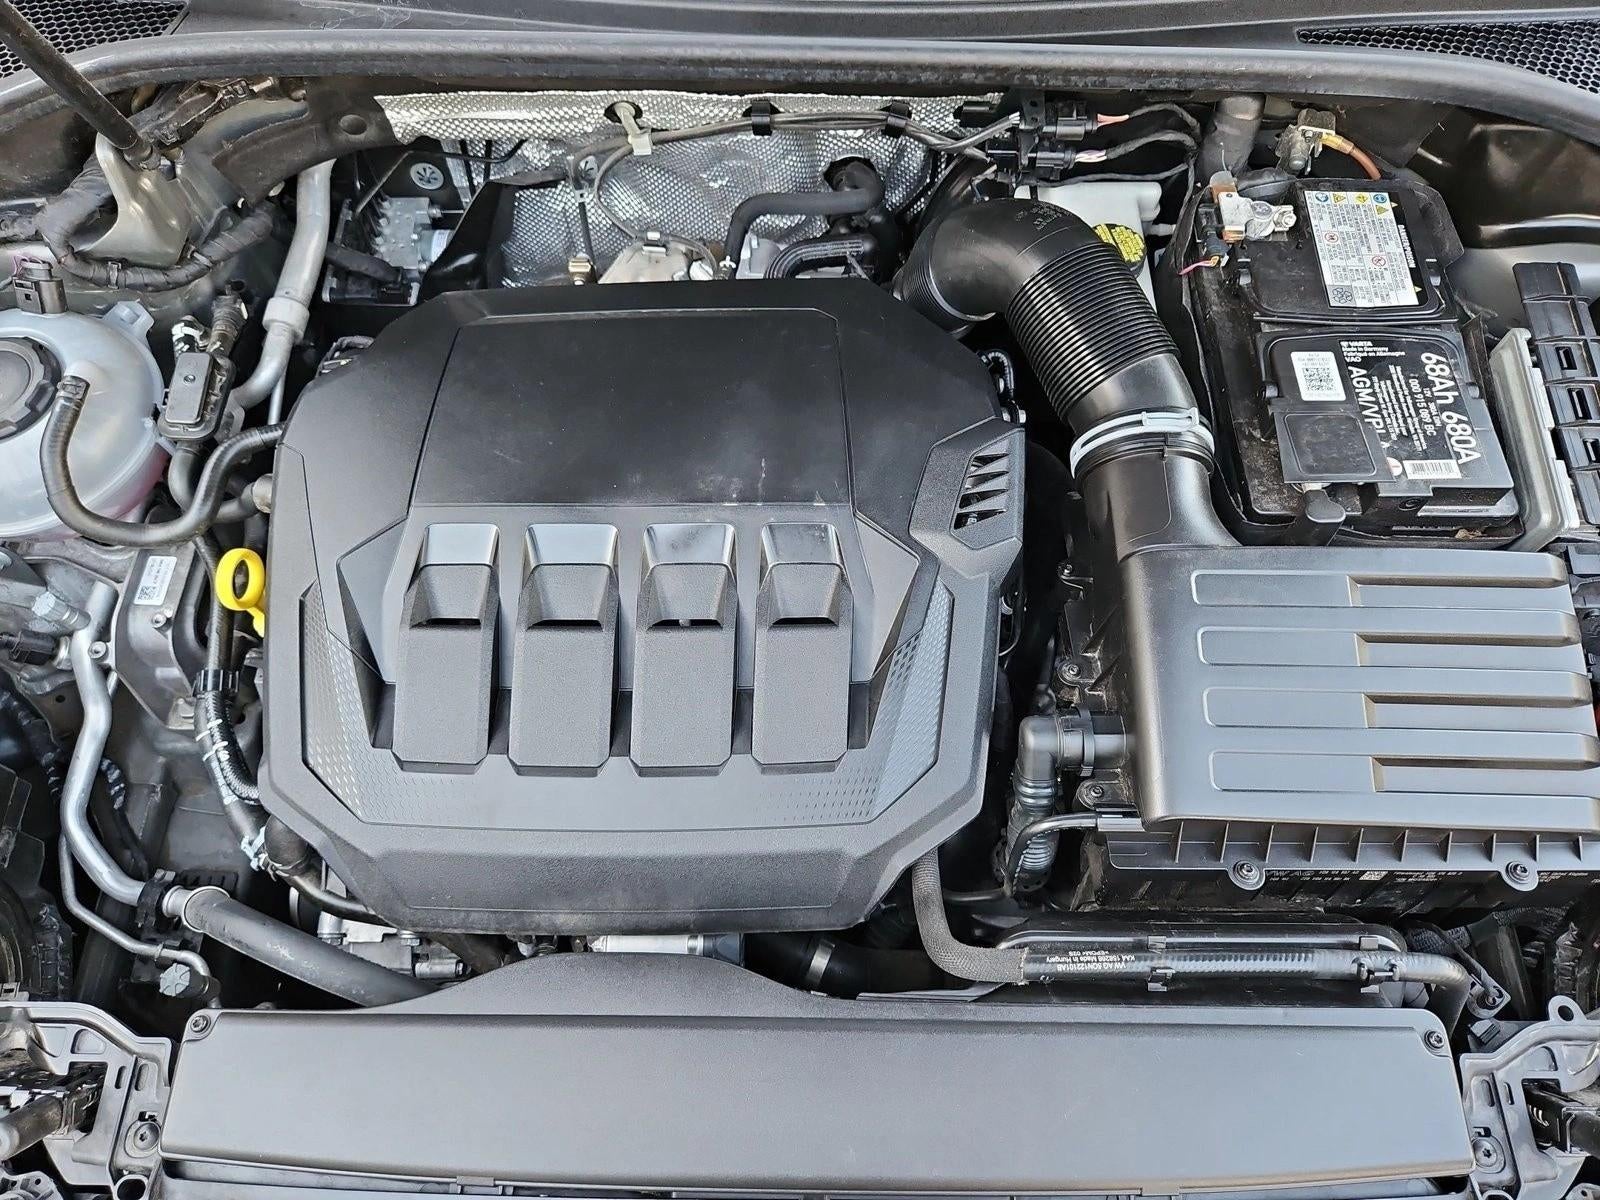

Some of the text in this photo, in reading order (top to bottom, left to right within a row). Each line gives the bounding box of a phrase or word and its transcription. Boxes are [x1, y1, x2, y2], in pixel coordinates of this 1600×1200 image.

[1409, 379, 1422, 393] 000
[1414, 394, 1427, 408] 915
[1421, 352, 1459, 404] 68Ah
[1441, 411, 1482, 465] 680A
[1424, 424, 1437, 436] BC
